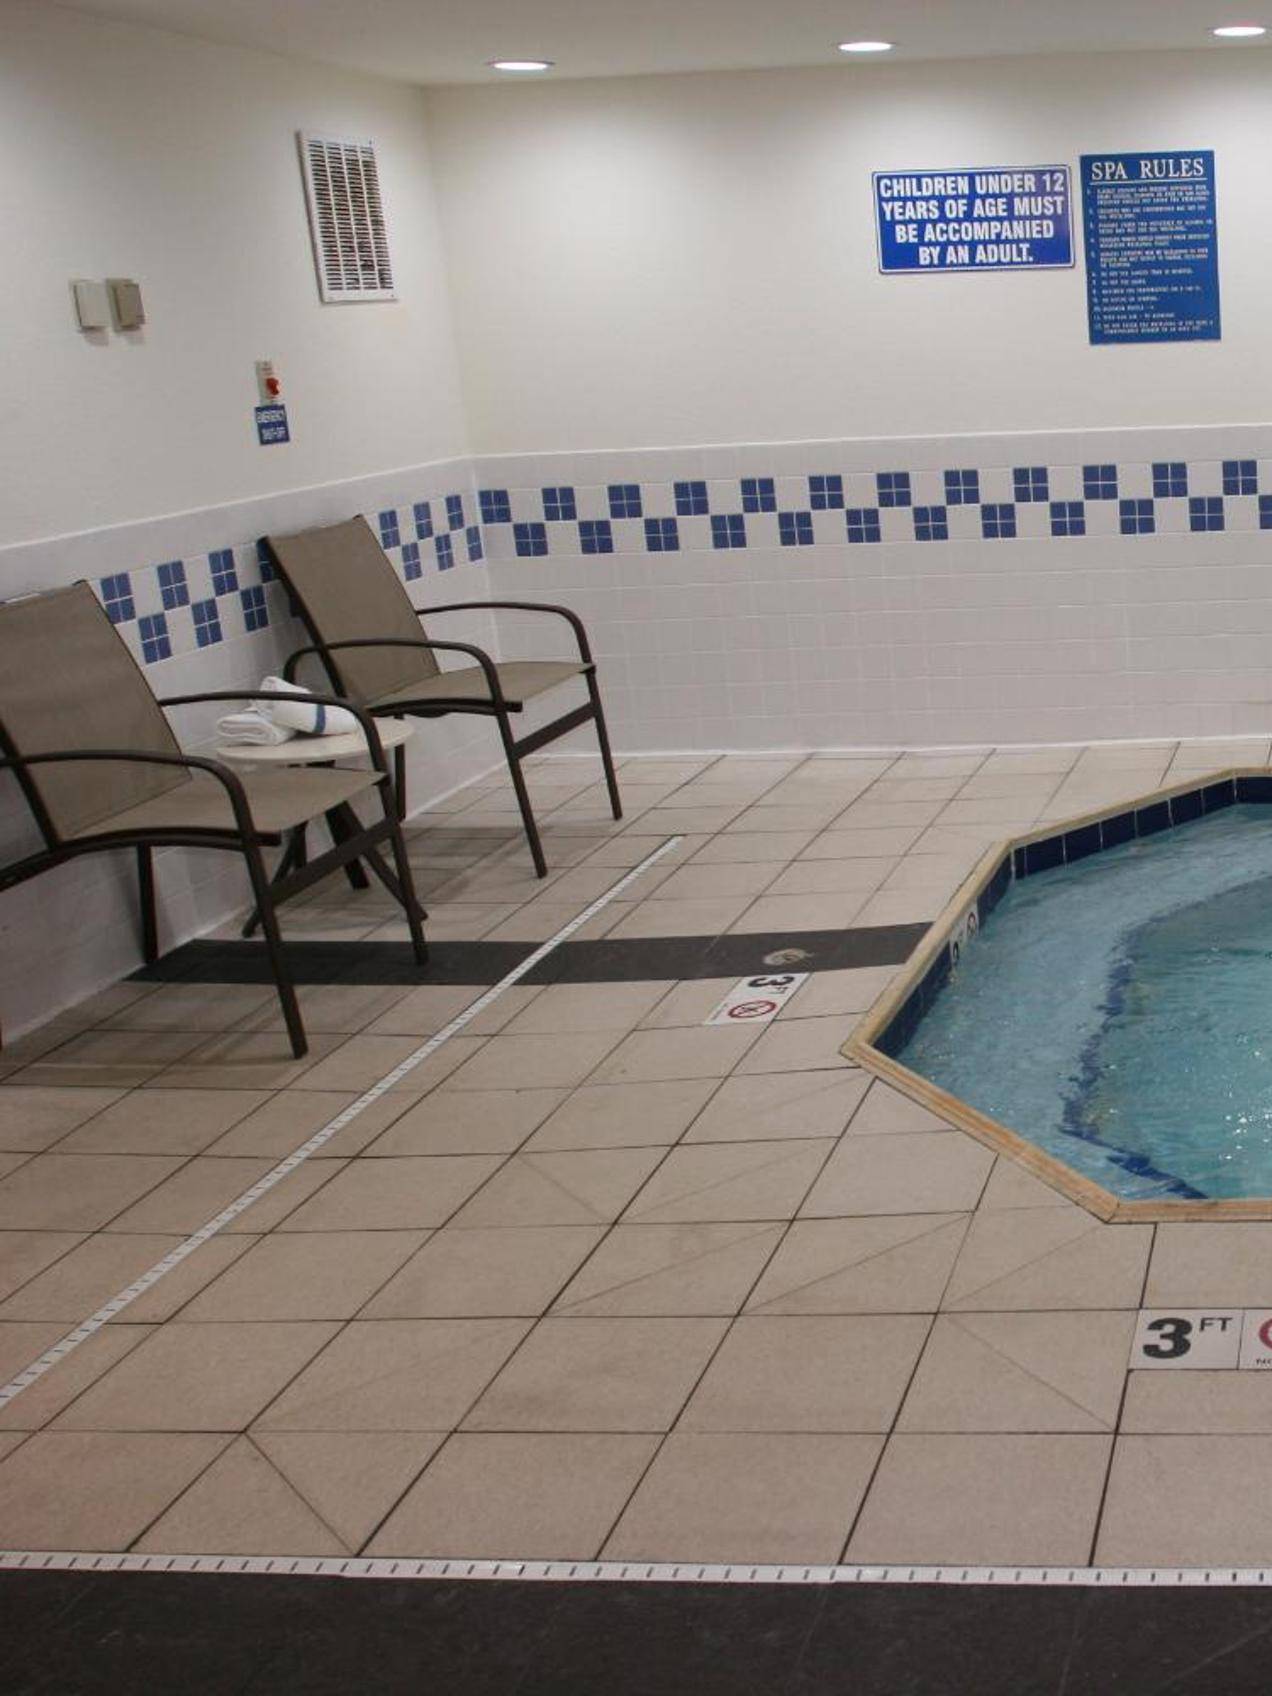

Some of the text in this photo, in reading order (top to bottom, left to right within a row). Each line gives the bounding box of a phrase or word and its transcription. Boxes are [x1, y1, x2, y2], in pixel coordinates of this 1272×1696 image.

[1091, 158, 1204, 180] SPA RULES
[880, 172, 1064, 198] CHILDREN UNDER 12
[881, 200, 939, 221] YEARS
[944, 199, 968, 219] OF
[973, 198, 1008, 217] AGE
[1013, 196, 1065, 216] MUST
[895, 219, 1054, 243] BE ACCOMPANIED
[919, 243, 1034, 266] BY AN ADULT.
[748, 976, 794, 988] 3
[1142, 1317, 1233, 1359] 3 FT
